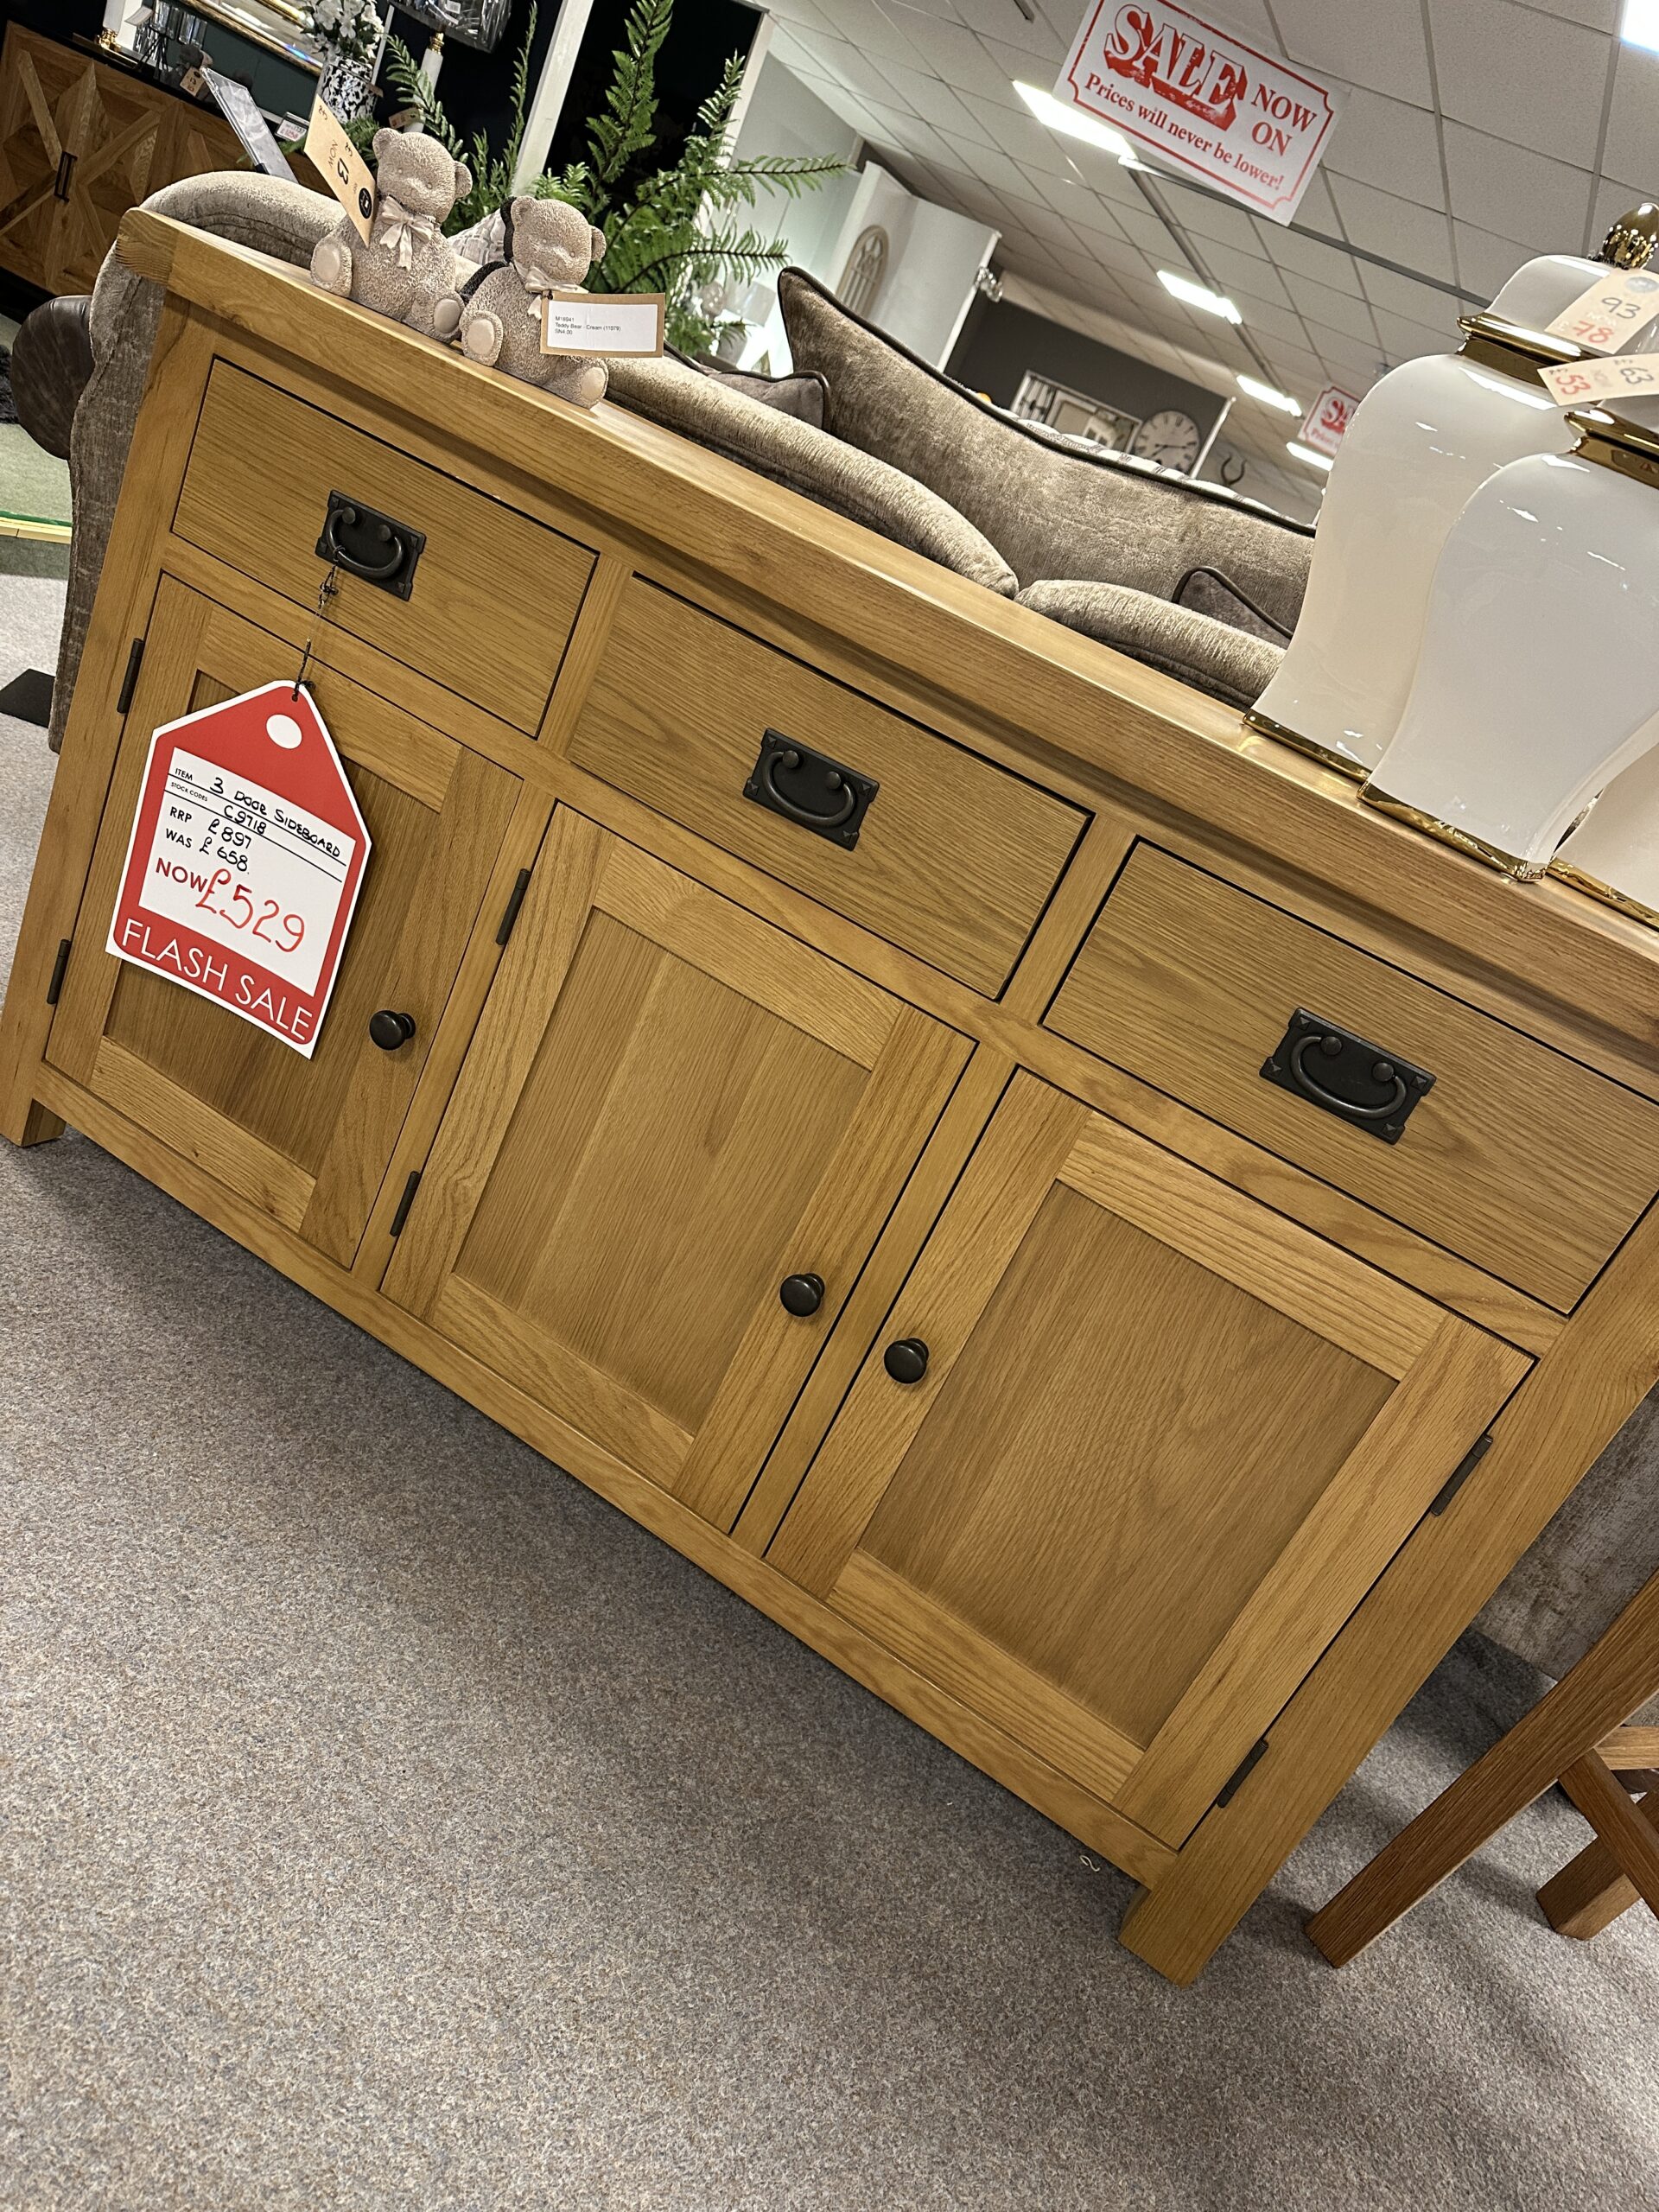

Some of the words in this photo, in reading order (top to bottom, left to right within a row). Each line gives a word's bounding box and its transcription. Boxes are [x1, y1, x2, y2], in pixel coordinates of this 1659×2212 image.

[1103, 3, 1248, 131] SALE
[1251, 83, 1317, 132] NOW
[1084, 73, 1135, 112] Prices
[1138, 101, 1167, 130] will
[1167, 123, 1212, 155] never
[1213, 142, 1233, 164] be
[1234, 154, 1284, 191] lower!
[1251, 121, 1293, 157] ON
[1572, 320, 1615, 344] 78
[1601, 296, 1642, 320] 93
[169, 806, 192, 823] RRP
[170, 782, 188, 793] STOCK
[189, 789, 208, 802] CODES
[224, 804, 267, 836] C9718
[175, 767, 193, 781] ITEM
[209, 777, 224, 795] 3
[234, 791, 268, 815] DOOR
[274, 809, 340, 857] SIDEBOARD
[166, 828, 193, 848] WAS
[156, 857, 207, 893] NOW
[195, 868, 305, 952] £529
[122, 918, 228, 991] FLASH
[234, 974, 313, 1041] SALE
